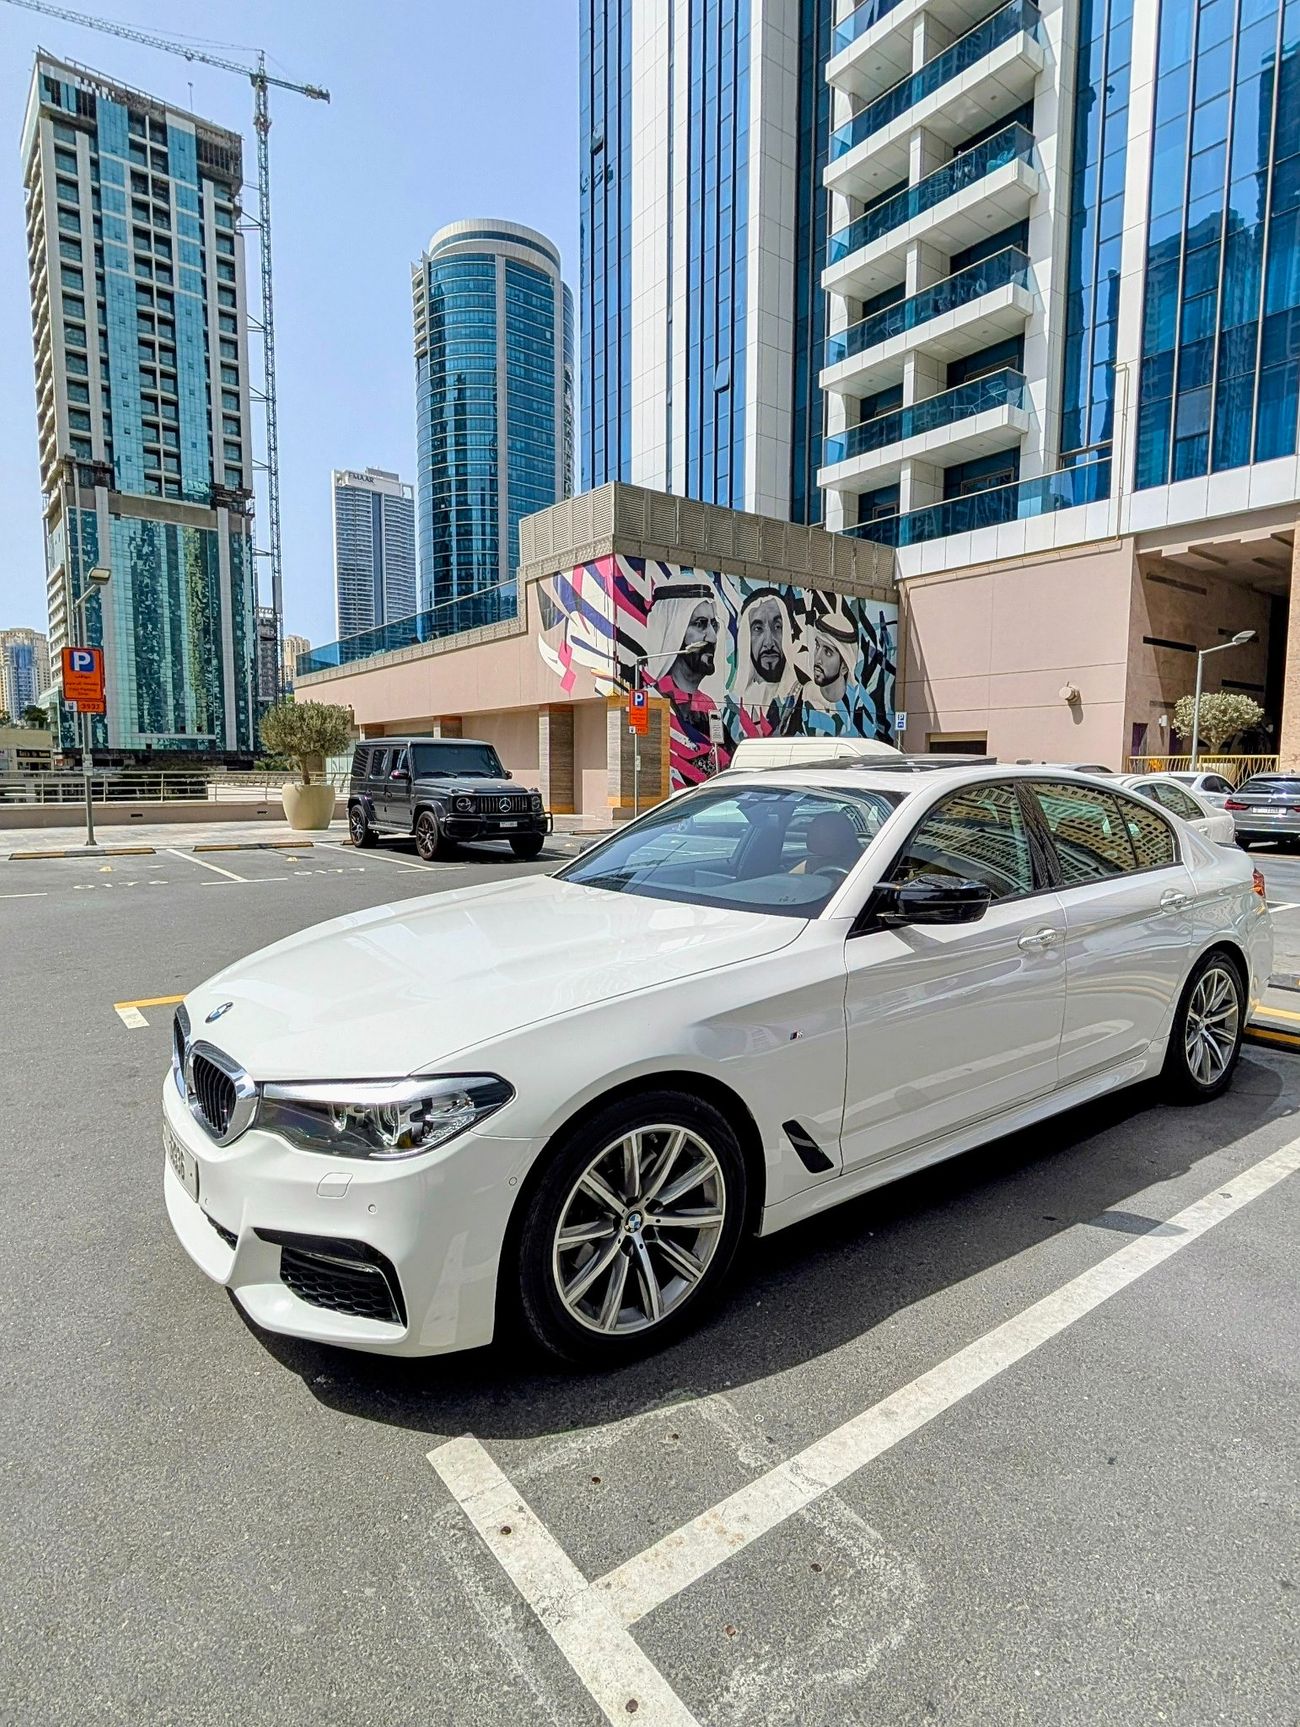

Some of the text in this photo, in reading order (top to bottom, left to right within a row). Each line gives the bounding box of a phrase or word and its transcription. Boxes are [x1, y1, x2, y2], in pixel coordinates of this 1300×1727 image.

[348, 473, 375, 484] EMAAR
[73, 651, 90, 671] P
[635, 692, 643, 705] P
